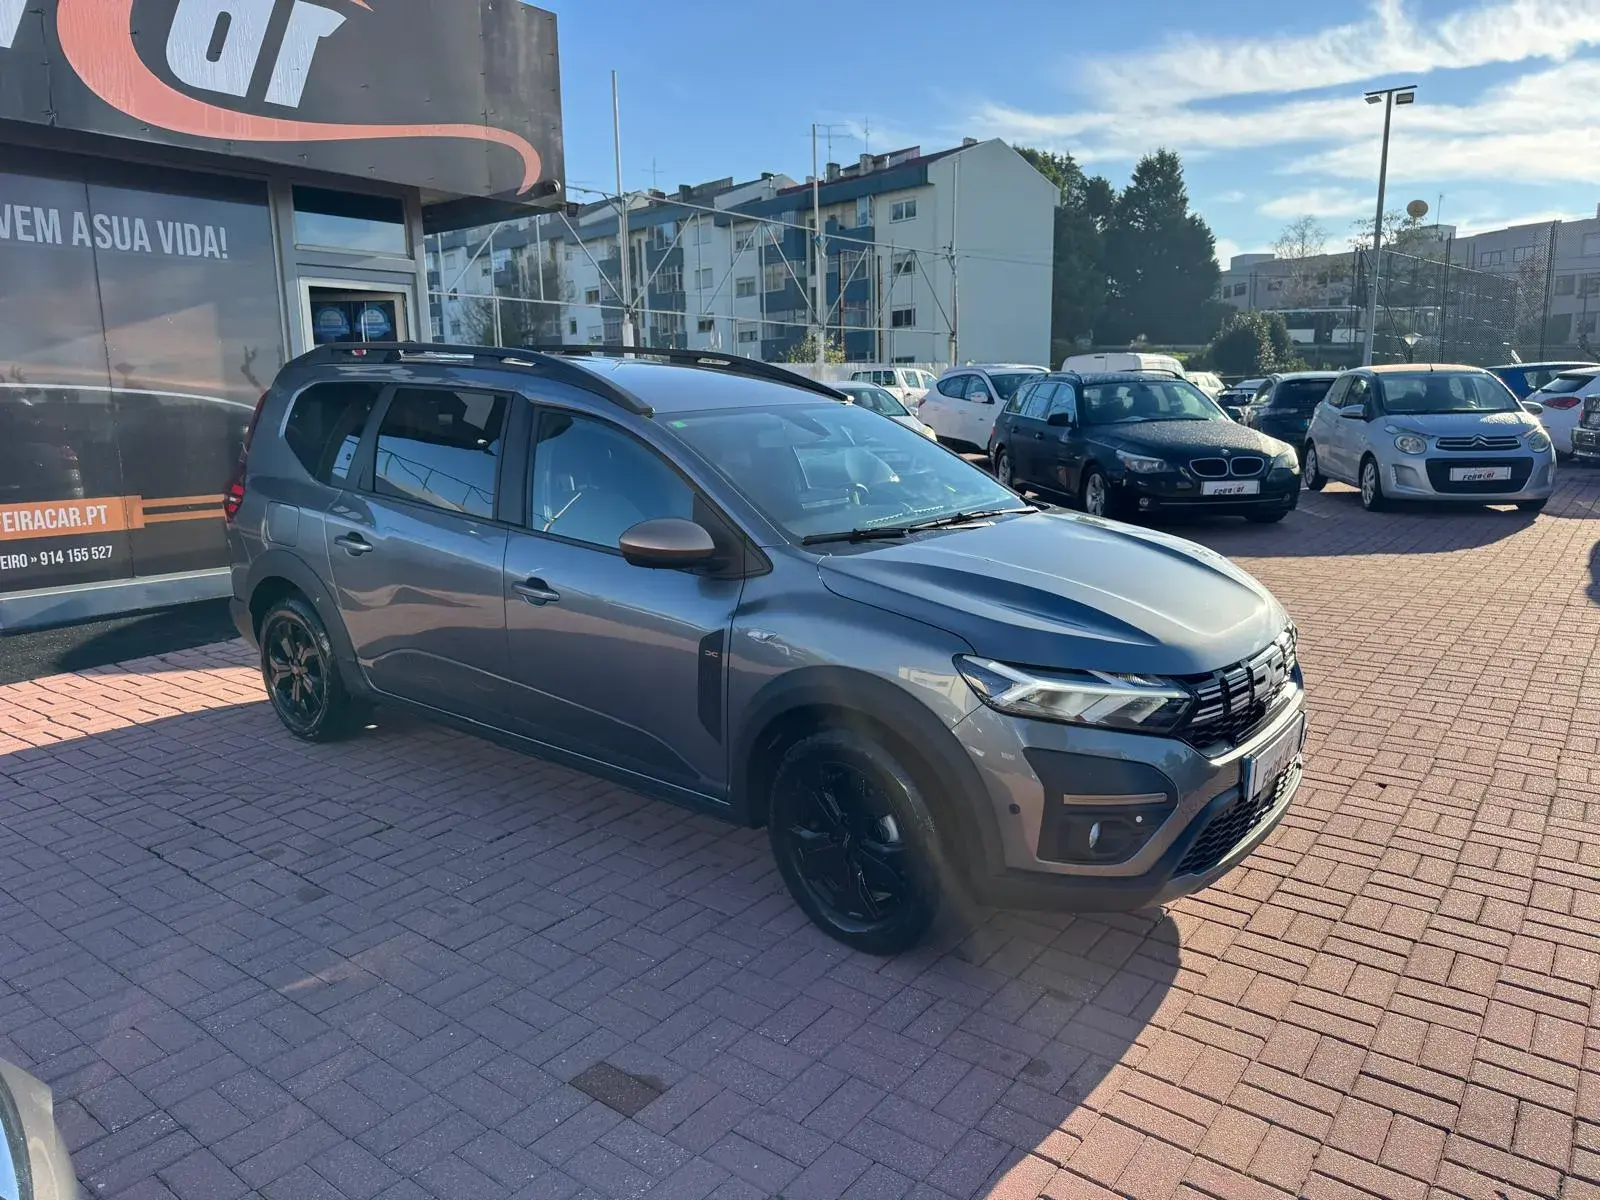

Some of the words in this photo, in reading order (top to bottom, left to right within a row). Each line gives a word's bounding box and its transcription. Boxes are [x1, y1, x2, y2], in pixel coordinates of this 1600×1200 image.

[156, 219, 229, 259] VIDA!
[0, 504, 108, 533] EIRACAR.PT
[40, 551, 64, 566] 914
[67, 547, 89, 563] 155
[91, 545, 113, 560] 527
